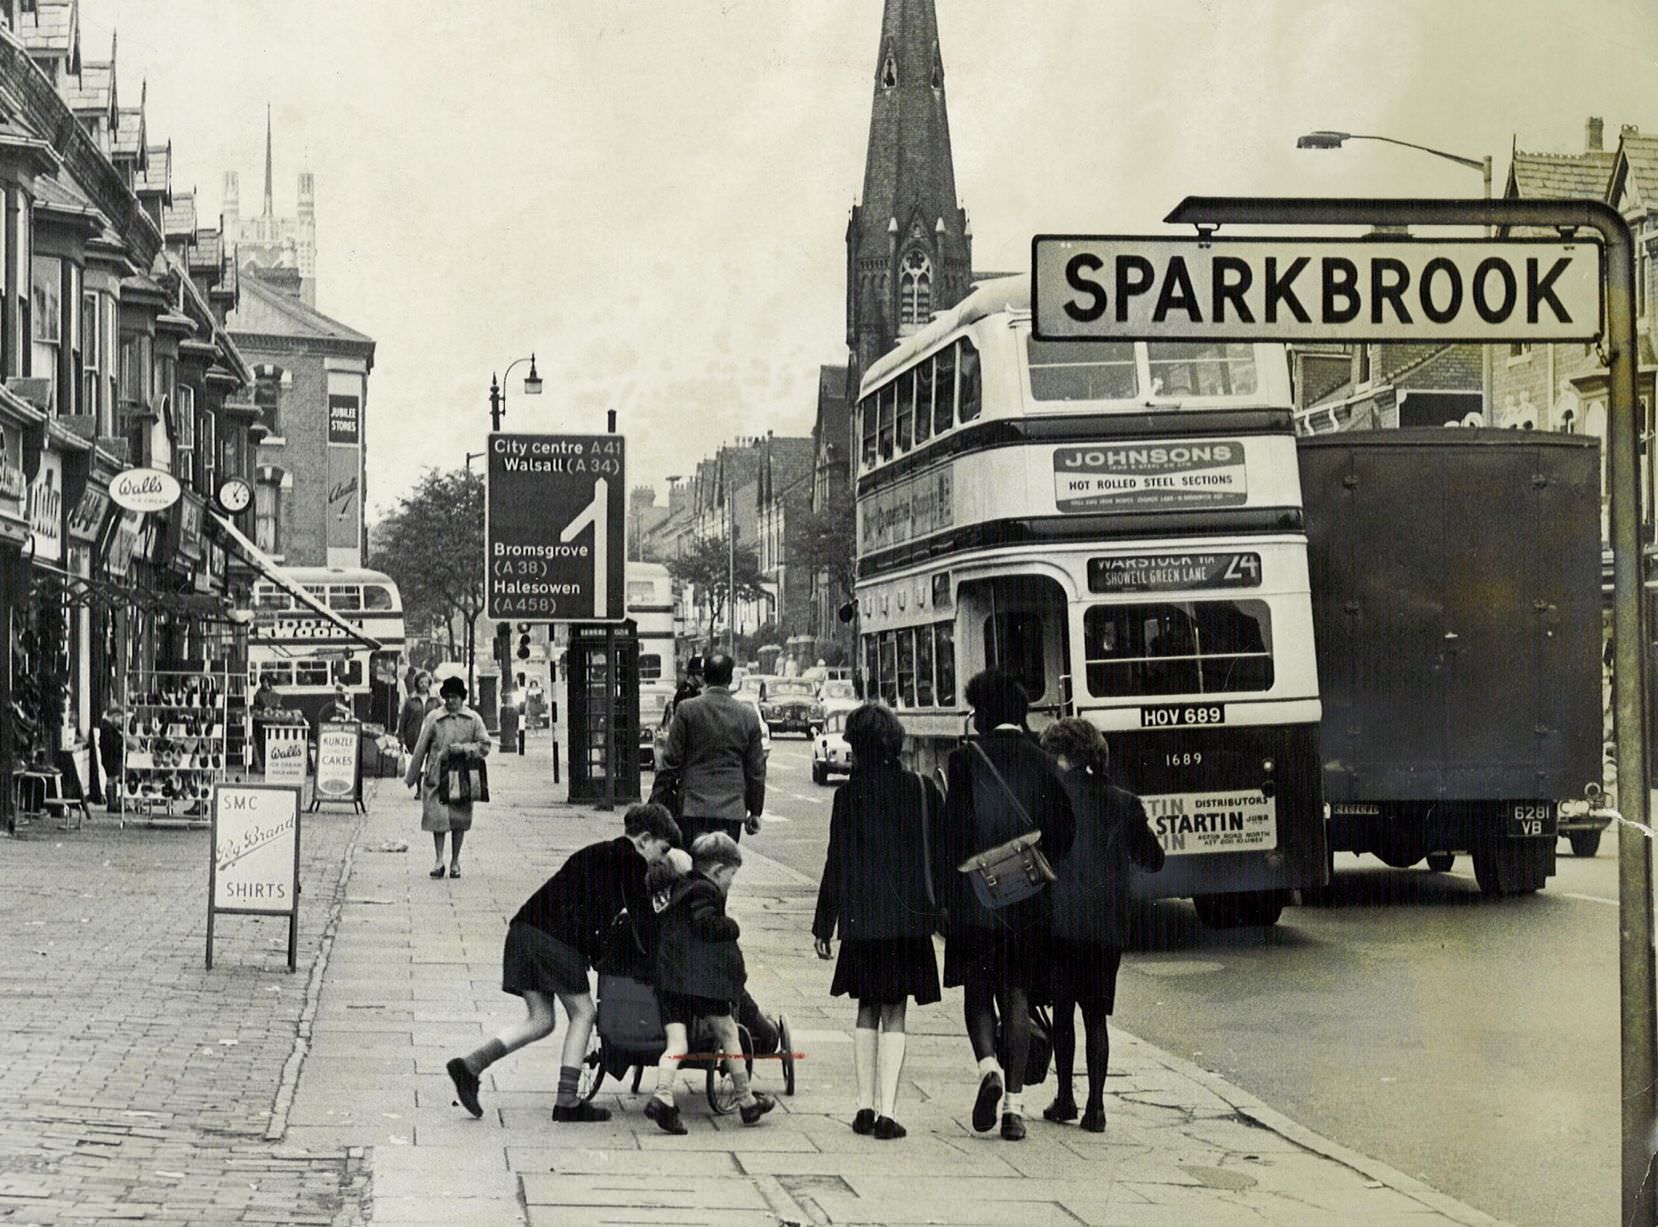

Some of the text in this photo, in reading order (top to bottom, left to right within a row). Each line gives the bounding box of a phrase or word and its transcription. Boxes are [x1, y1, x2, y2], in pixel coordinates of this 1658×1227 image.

[1063, 252, 1575, 325] SPARKBROOK
[331, 407, 356, 418] JUBILEE
[331, 420, 357, 432] STORES
[494, 438, 528, 456] City
[532, 440, 584, 454] centre
[504, 457, 563, 472] Walsall
[1065, 445, 1232, 467] JOHNSONS
[118, 475, 162, 495] Wall's
[1069, 474, 1233, 491] HOT ROLLED STEEL SECTIONS
[494, 542, 589, 559] Bromsgrove
[1105, 567, 1208, 585] SHOWELL GREEN LANE
[494, 579, 581, 595] Halesowen
[1143, 707, 1221, 726] HOV 689
[323, 737, 353, 747] KUNZLE
[322, 755, 353, 766] CAKES
[1165, 752, 1202, 767] 1689
[224, 796, 258, 810] SMC
[1141, 798, 1183, 816] TIN
[1195, 796, 1268, 809] DISTRIBUTORS
[1514, 805, 1550, 820] 6281
[244, 811, 296, 848] Brand
[1156, 812, 1243, 836] STARTIN
[1521, 820, 1542, 835] VB
[226, 881, 286, 899] SHIRTS
